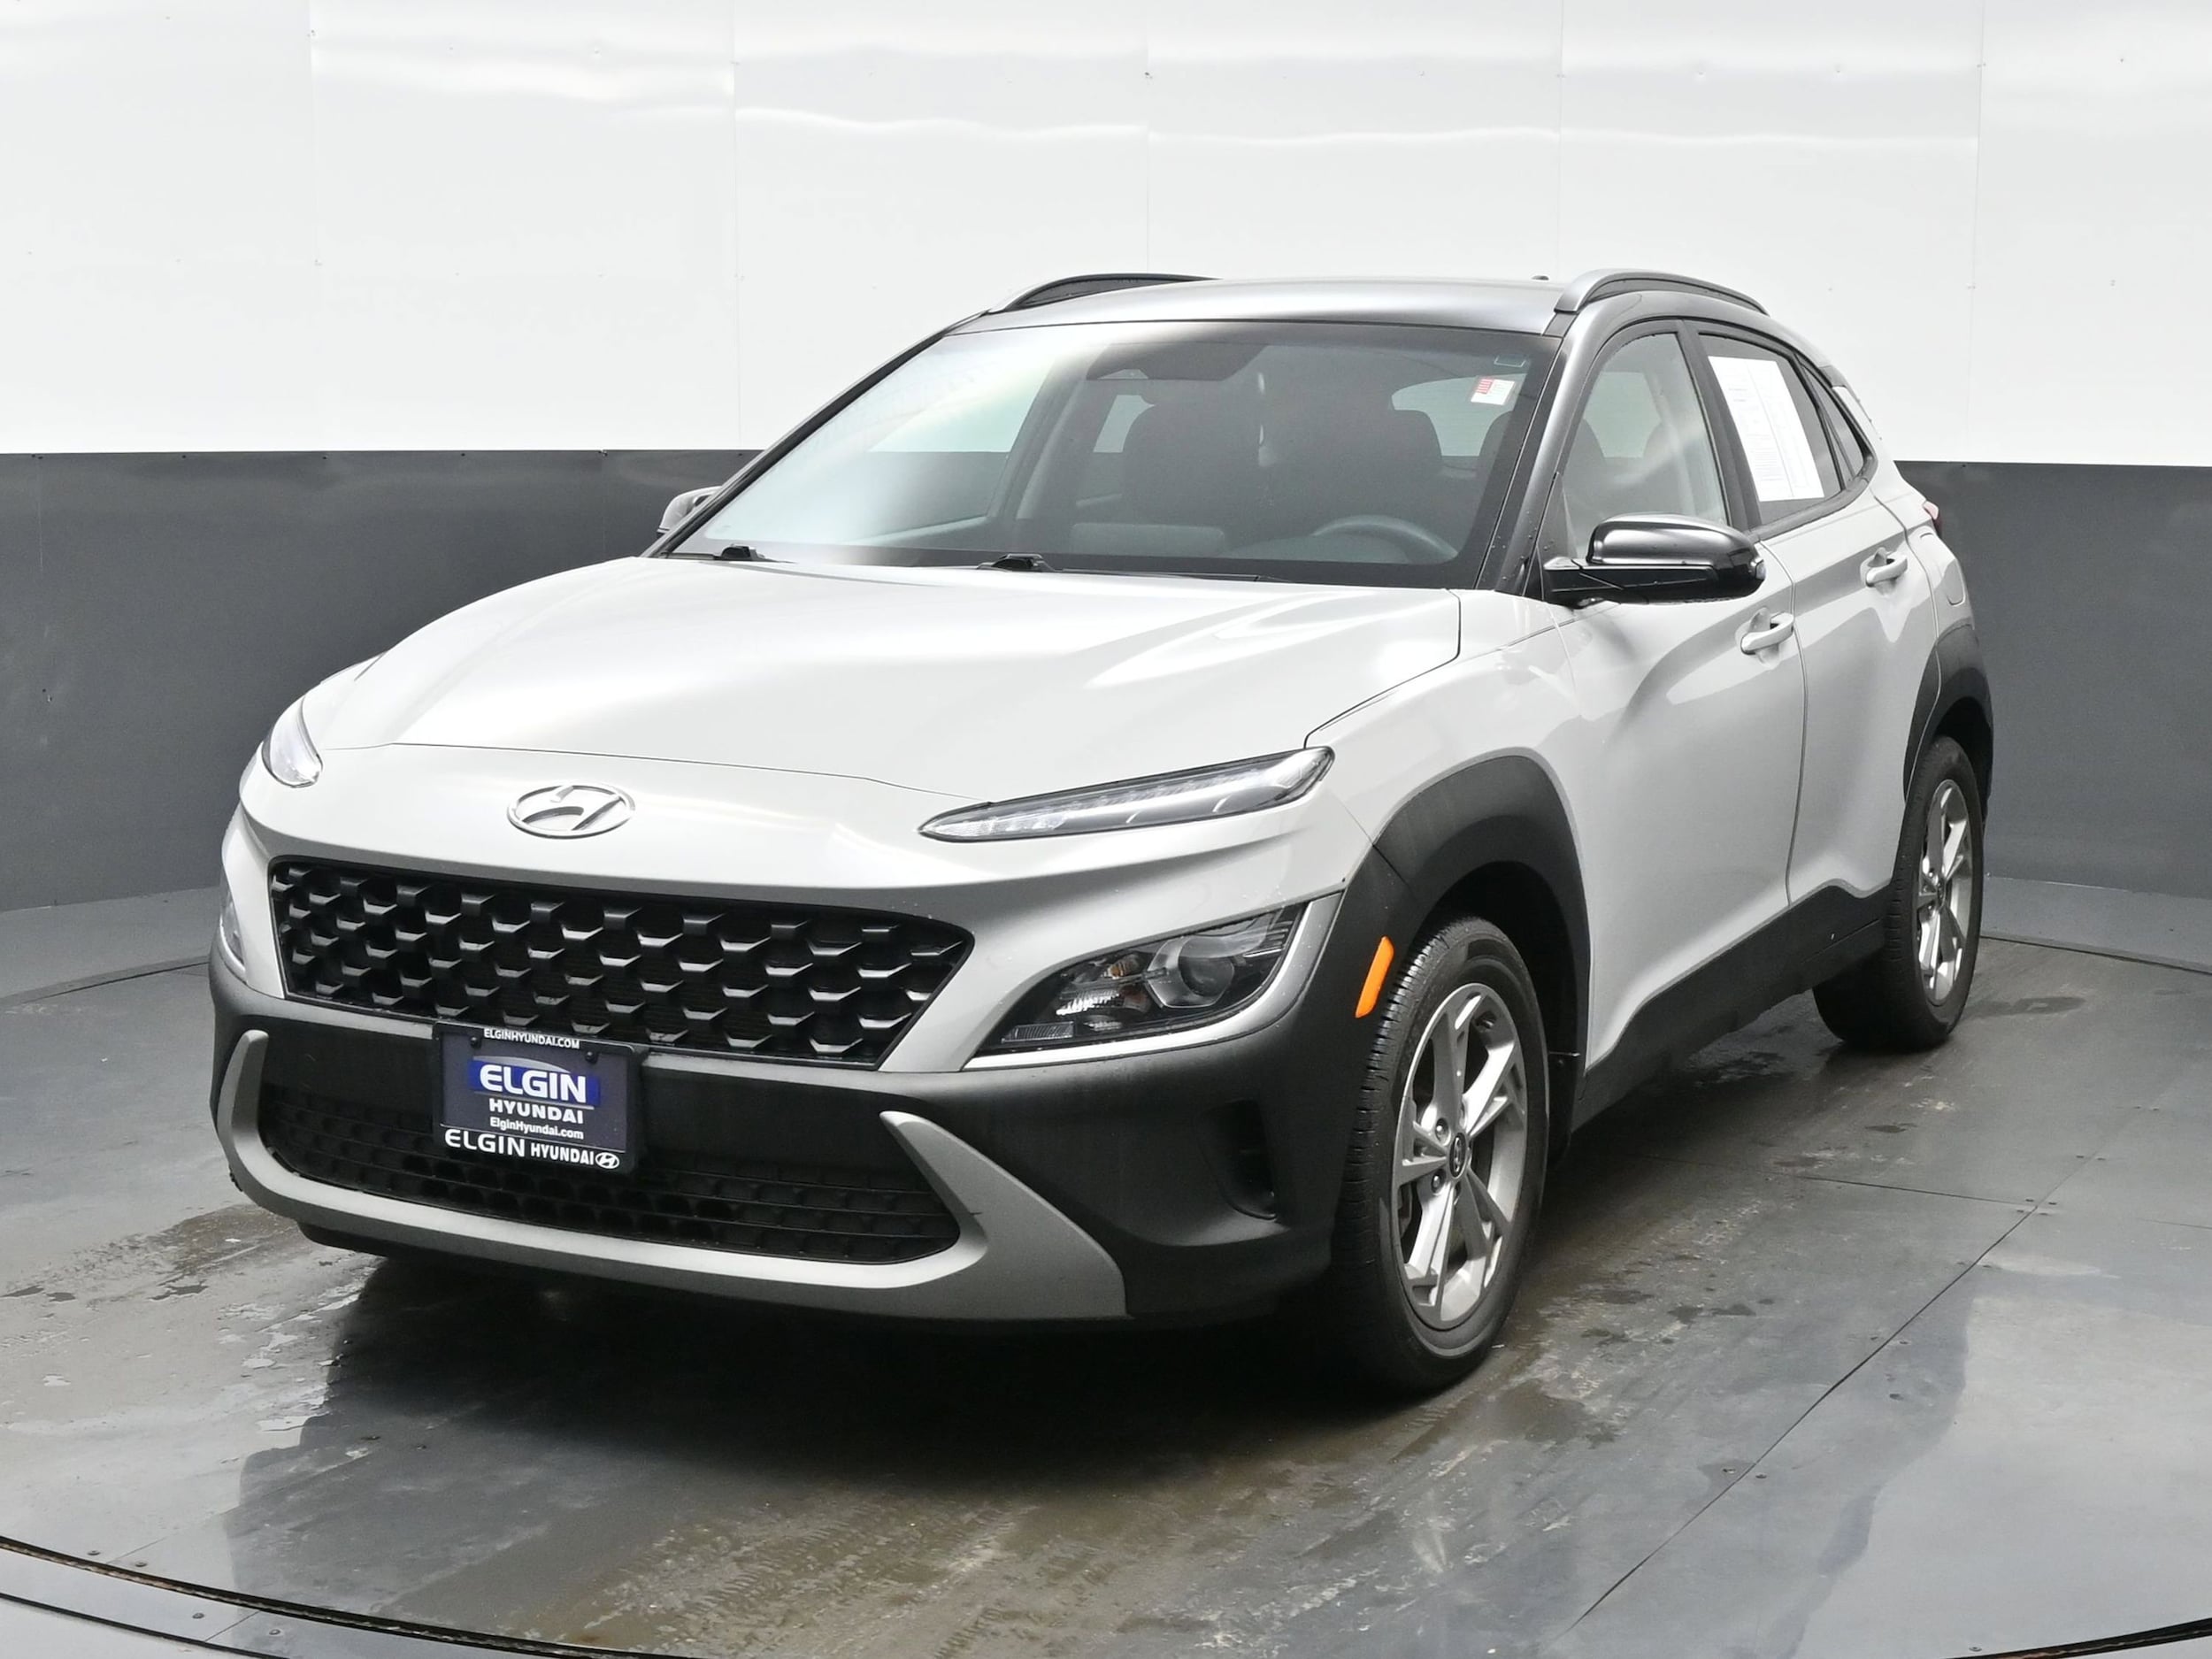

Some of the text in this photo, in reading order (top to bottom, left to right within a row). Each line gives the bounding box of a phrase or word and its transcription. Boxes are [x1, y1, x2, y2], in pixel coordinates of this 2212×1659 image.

[480, 1064, 587, 1103] ELGIN
[488, 1098, 584, 1124] HYUNDAI
[490, 1117, 584, 1140] ElginHyundai.com
[444, 1128, 594, 1165] ELGIN HYUNDAI
